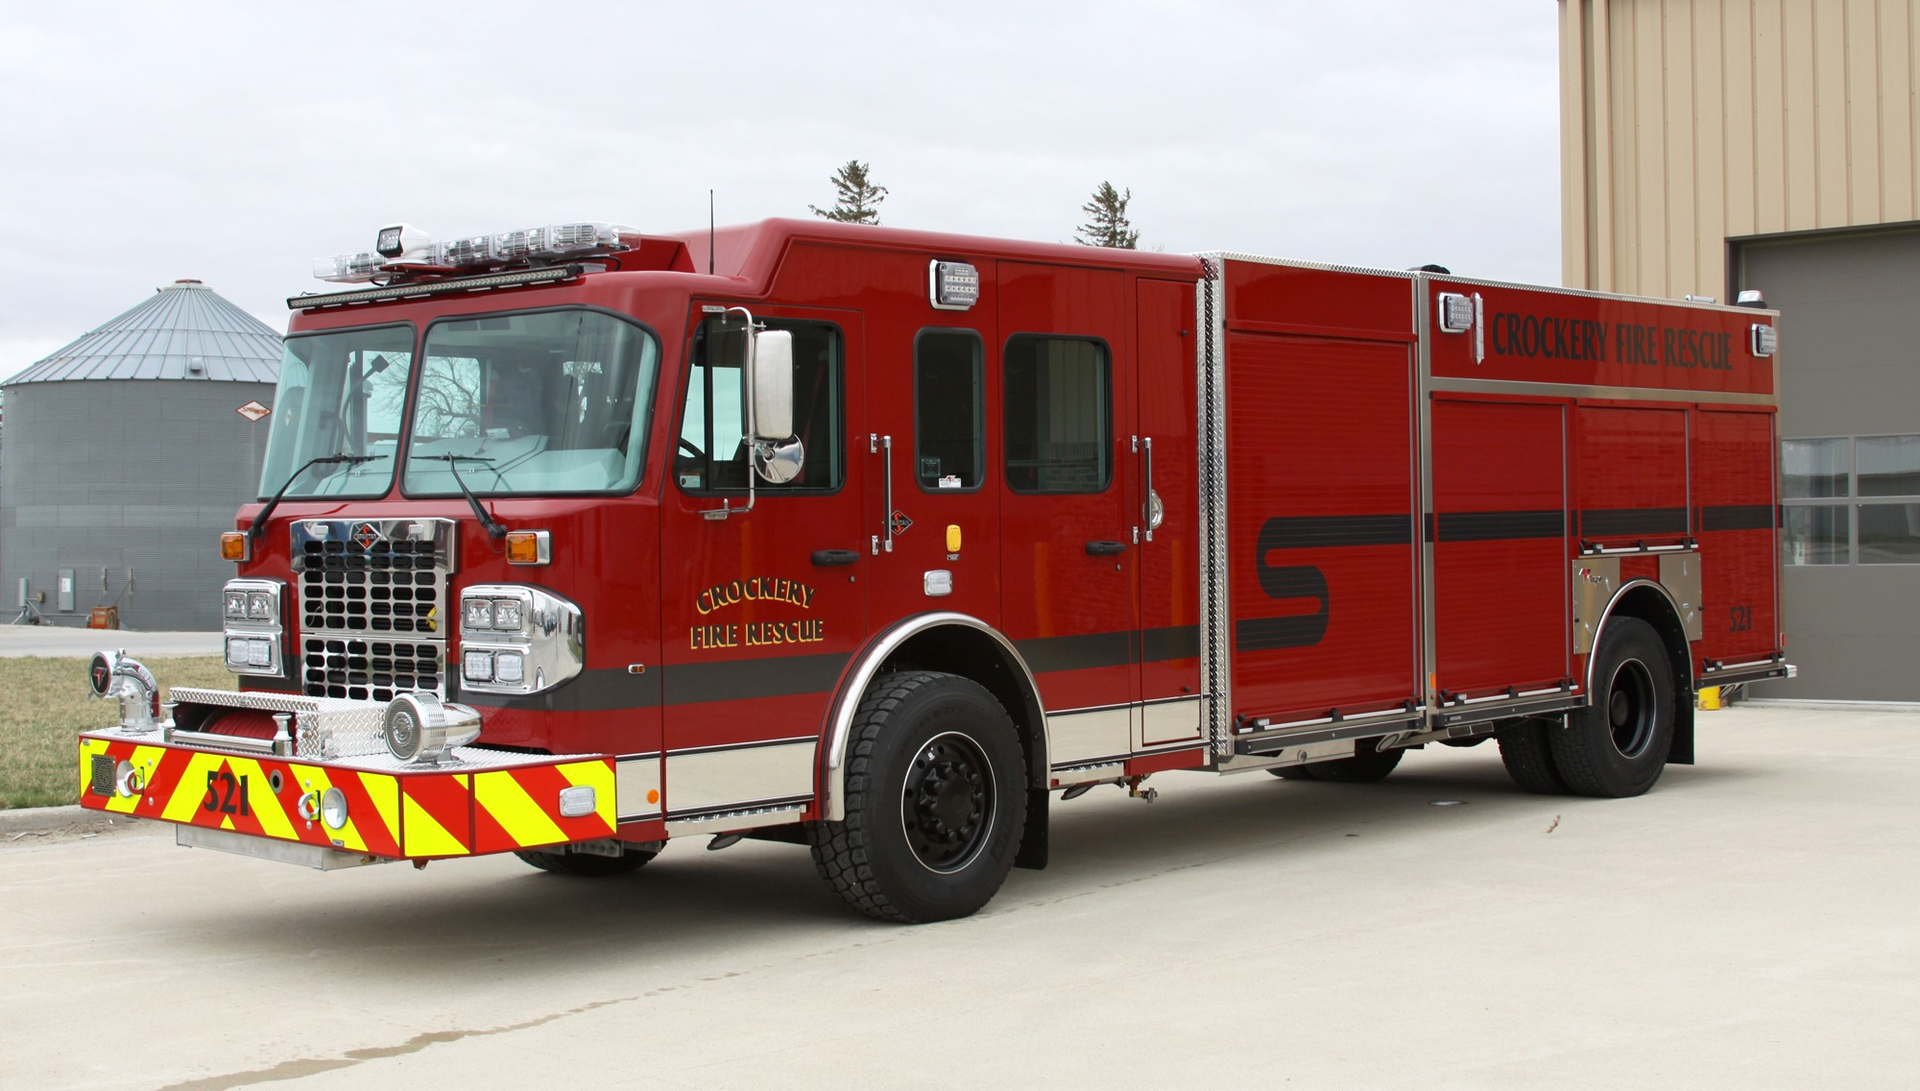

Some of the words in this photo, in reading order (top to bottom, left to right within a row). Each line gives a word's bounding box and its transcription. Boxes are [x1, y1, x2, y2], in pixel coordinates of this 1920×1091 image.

[1493, 312, 1609, 362] CROCKERY
[1616, 323, 1658, 366] FIRE
[1664, 327, 1733, 371] RESCUE
[696, 577, 817, 615] CROCKERY
[690, 623, 738, 650] FIRE
[745, 619, 824, 646] RESCUE
[1728, 605, 1752, 632] 521
[203, 770, 249, 817] 521
